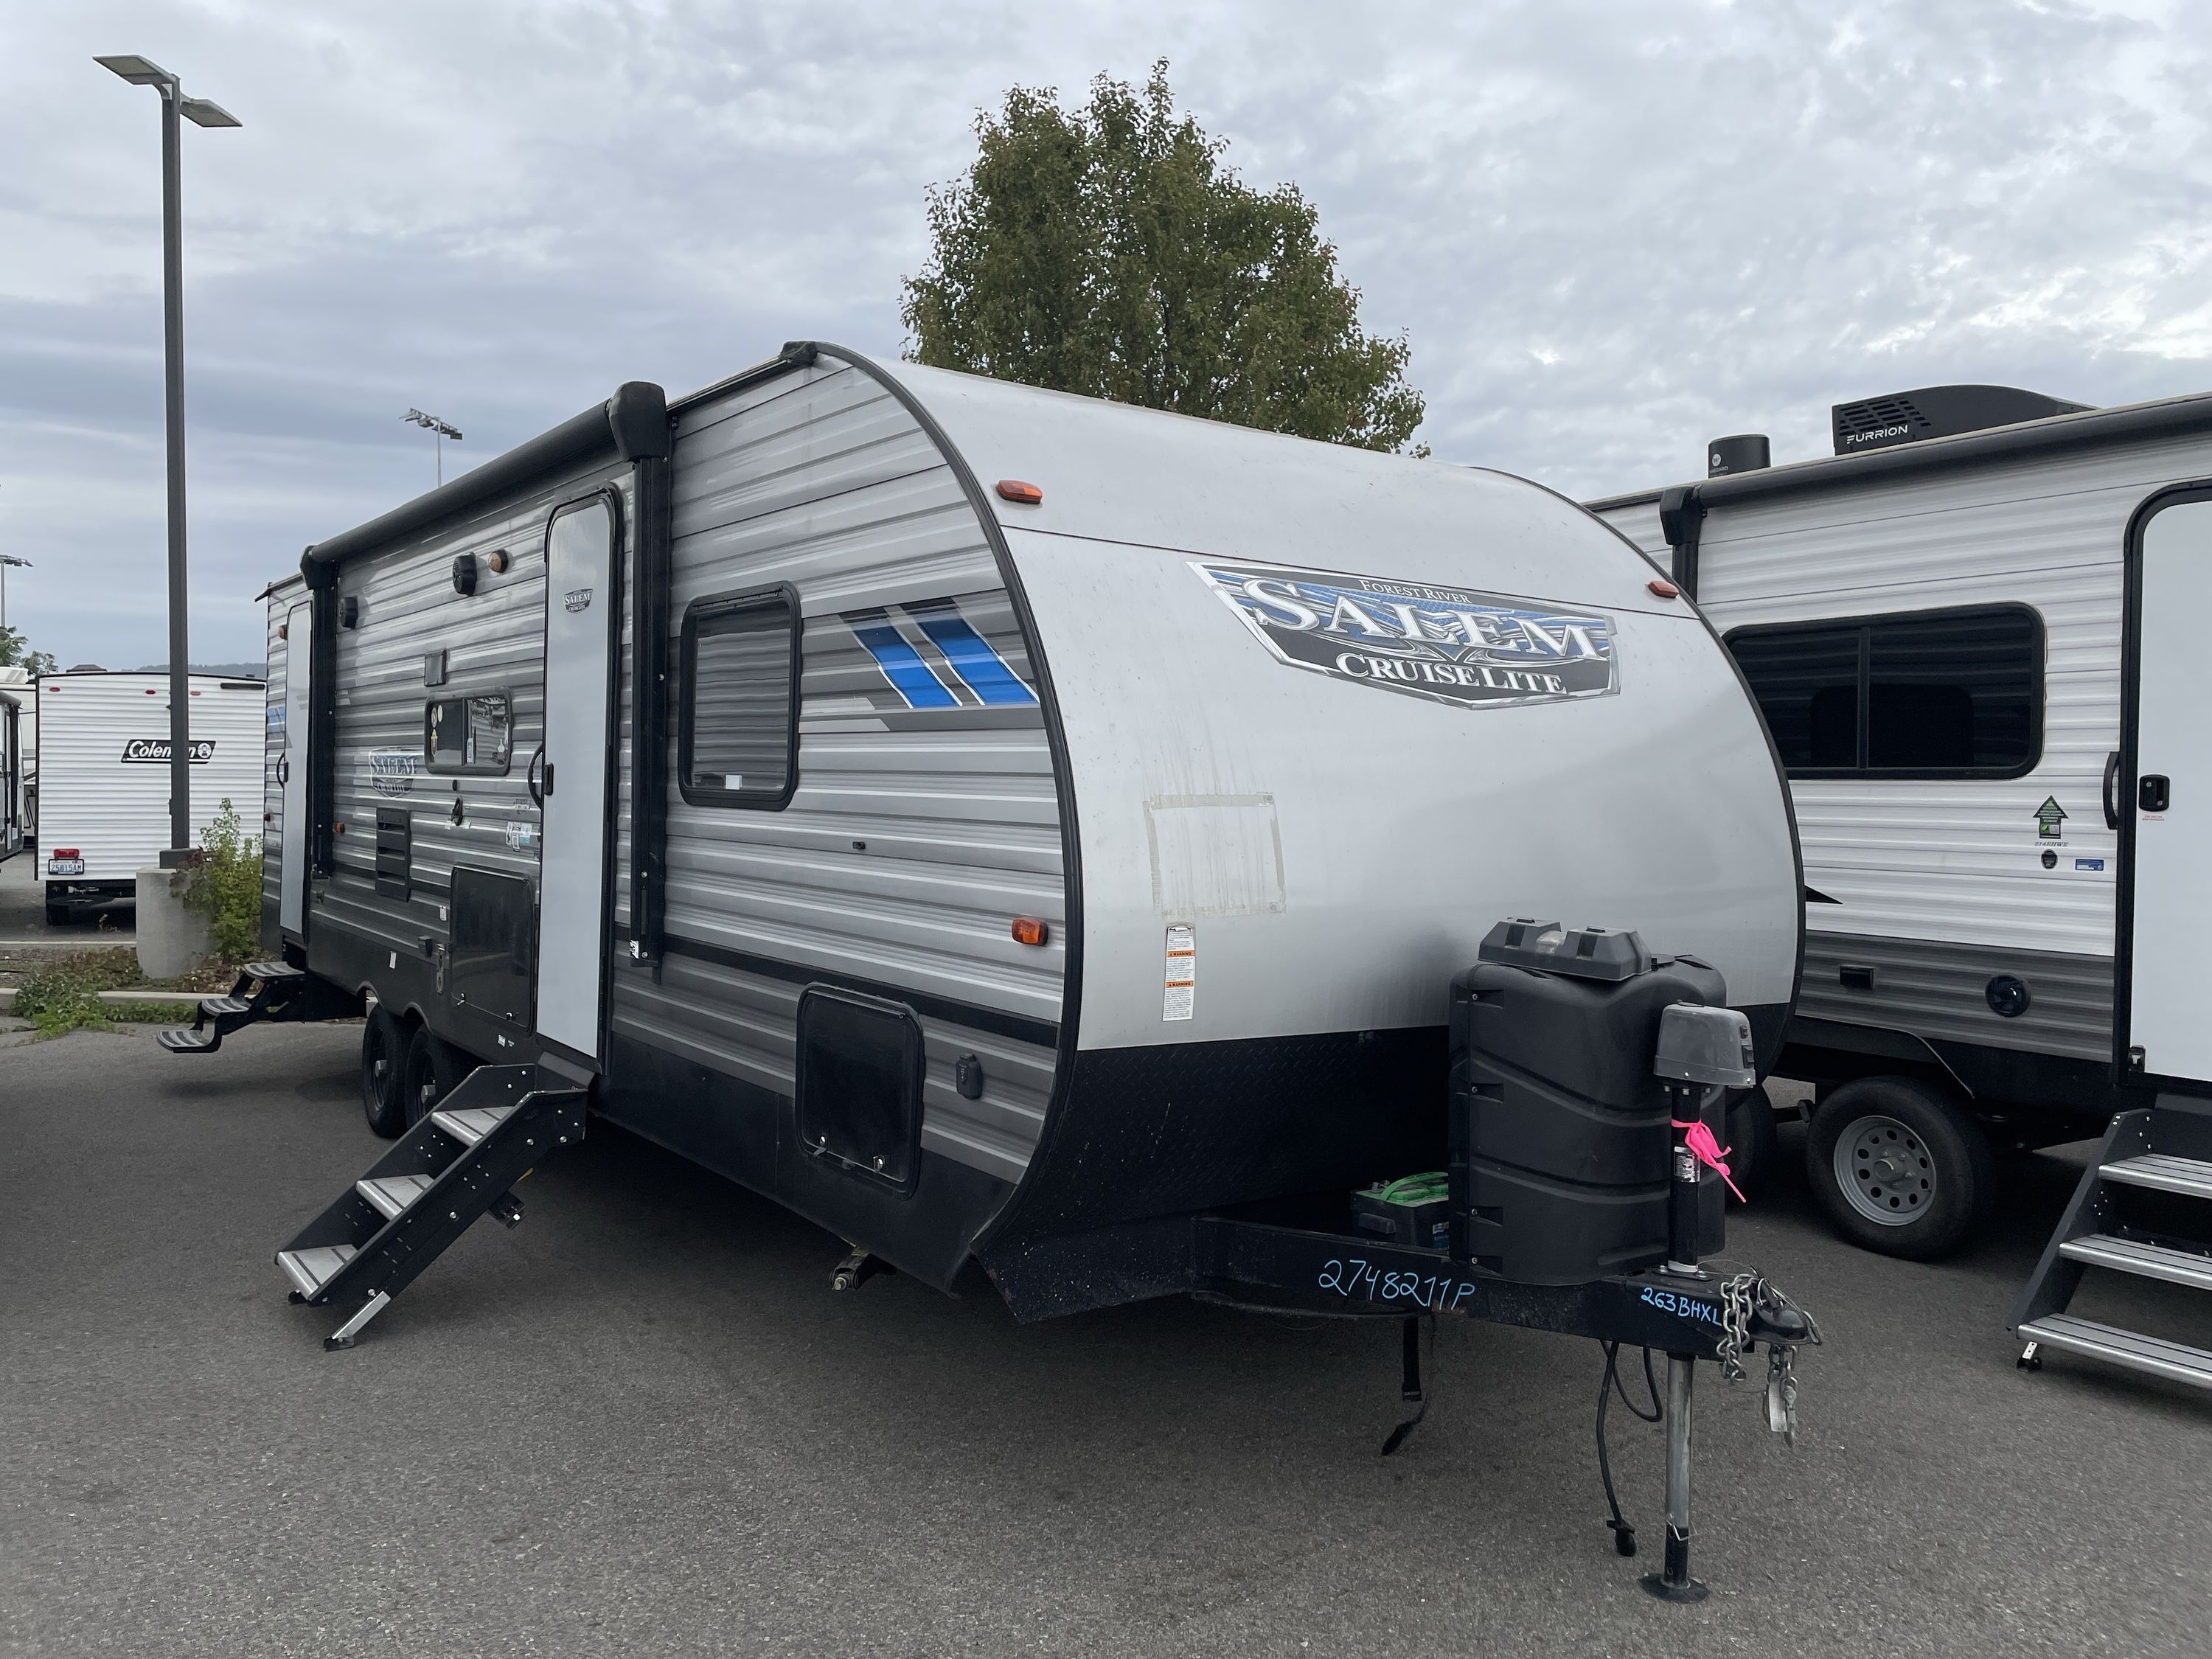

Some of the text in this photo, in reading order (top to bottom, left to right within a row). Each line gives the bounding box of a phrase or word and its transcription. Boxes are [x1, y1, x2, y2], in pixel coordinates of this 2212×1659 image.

[1847, 425, 1908, 445] FURRION
[1358, 579, 1472, 604] FOREST RIVER
[1242, 577, 1610, 662] SALEM
[128, 740, 197, 758] Colemn
[1641, 1287, 1722, 1326] 263BHXL
